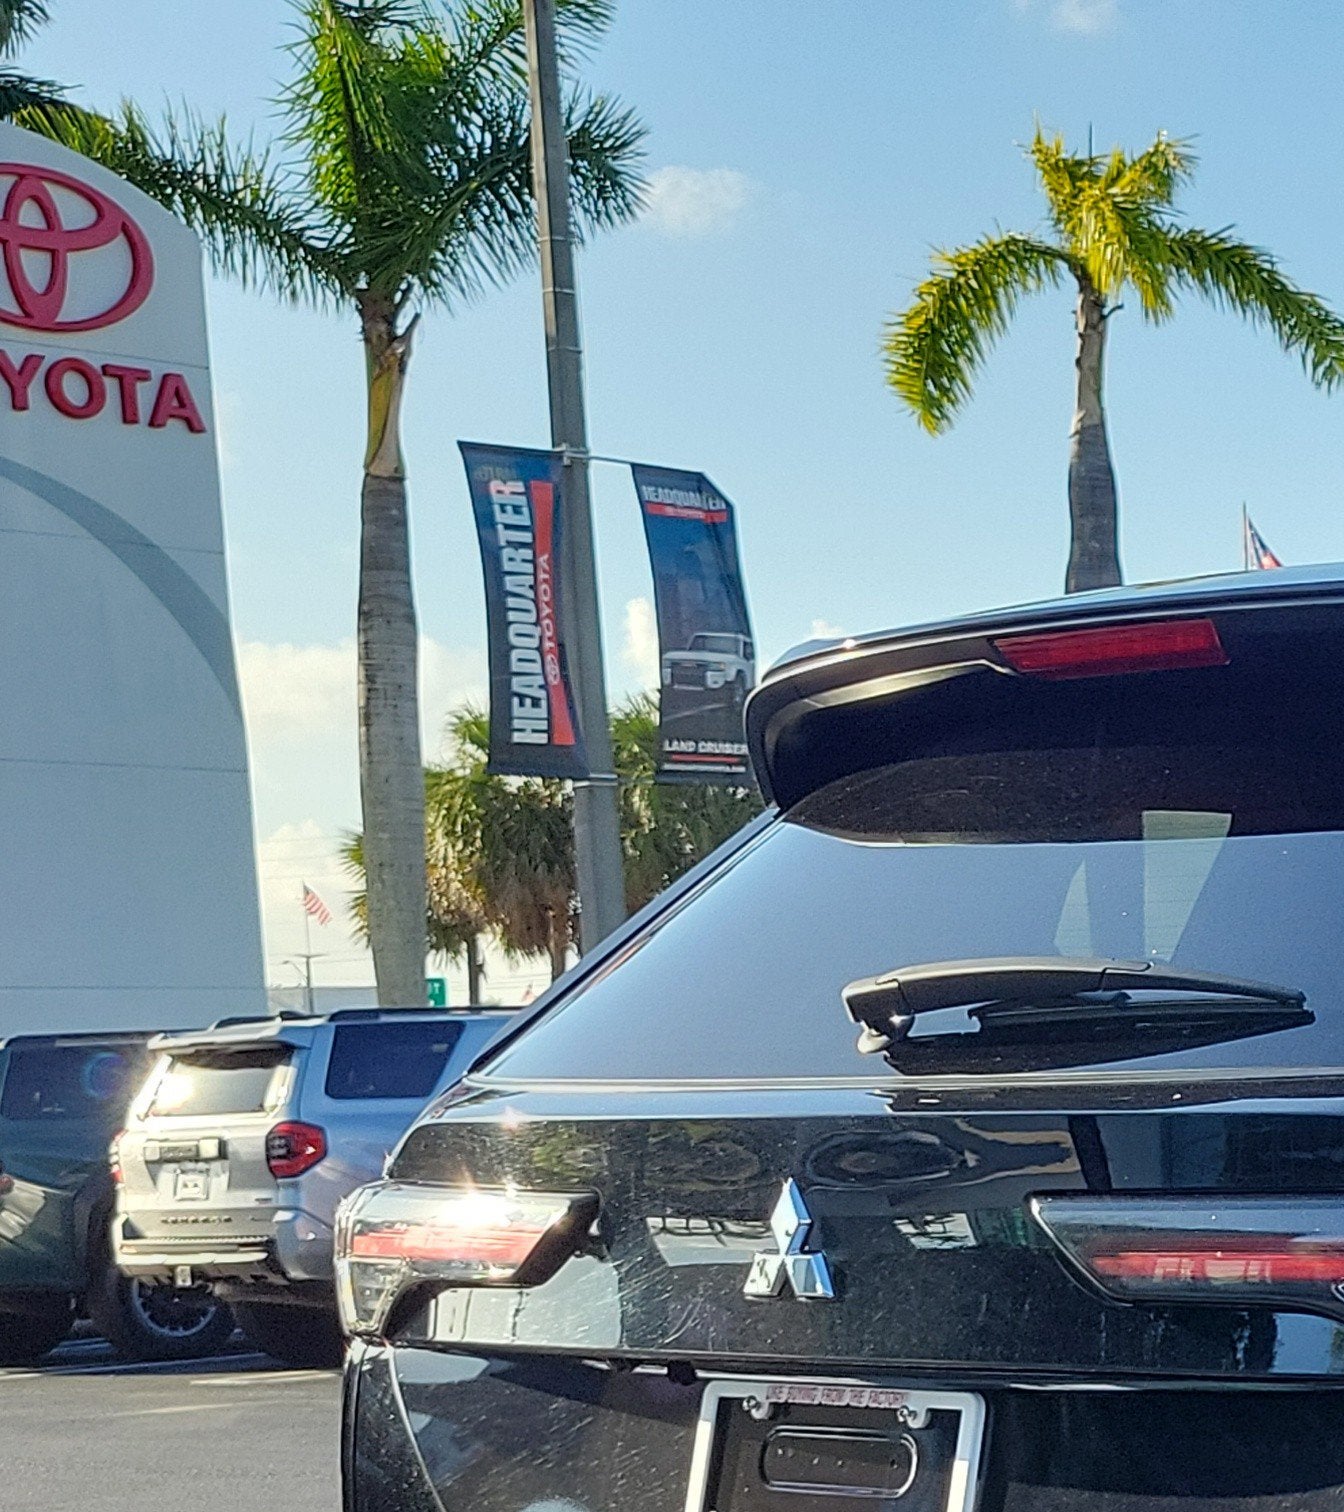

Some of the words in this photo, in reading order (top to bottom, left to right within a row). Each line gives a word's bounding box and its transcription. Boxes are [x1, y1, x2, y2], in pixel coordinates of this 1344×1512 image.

[489, 479, 549, 744] HEADQUARTER
[537, 553, 557, 651] TOYOTA
[663, 740, 697, 752] LAND
